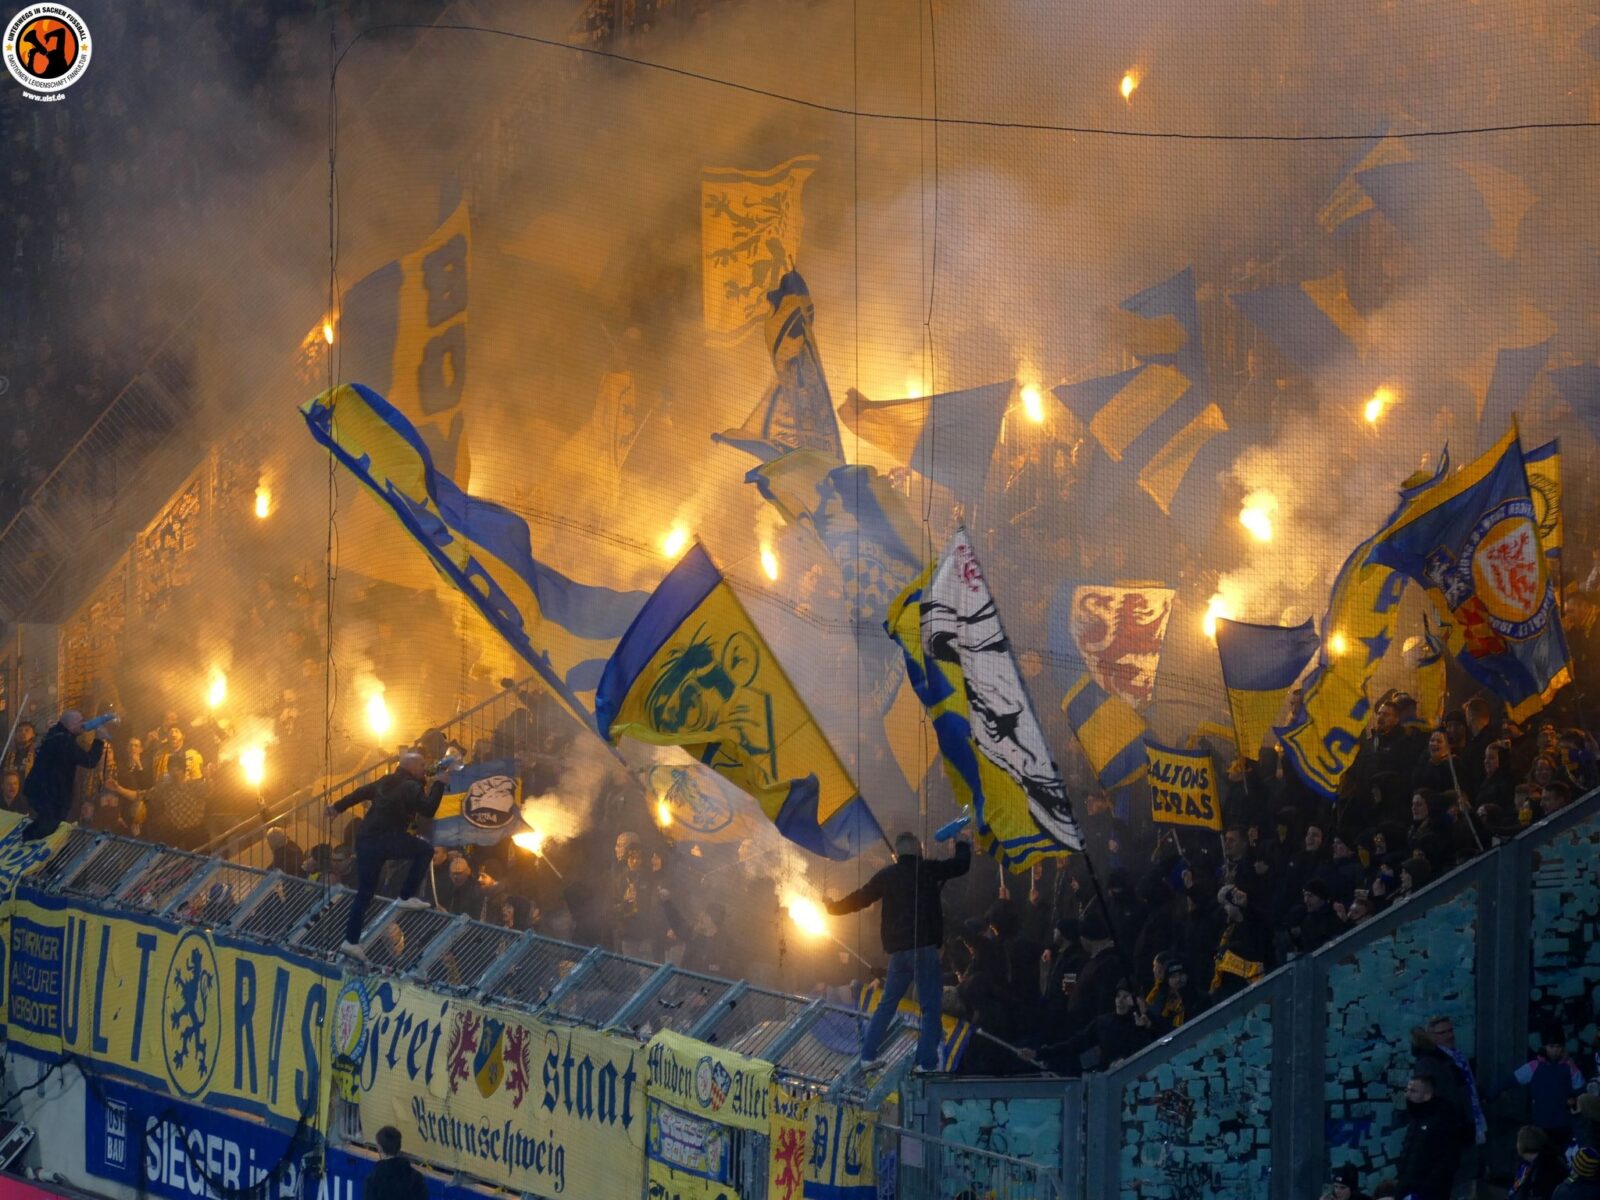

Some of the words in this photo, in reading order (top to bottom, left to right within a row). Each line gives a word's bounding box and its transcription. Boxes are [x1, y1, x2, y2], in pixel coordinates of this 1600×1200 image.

[107, 1136, 124, 1162] BAU
[146, 1116, 241, 1200] SIEGER
[411, 1096, 565, 1193] Braunschweig
